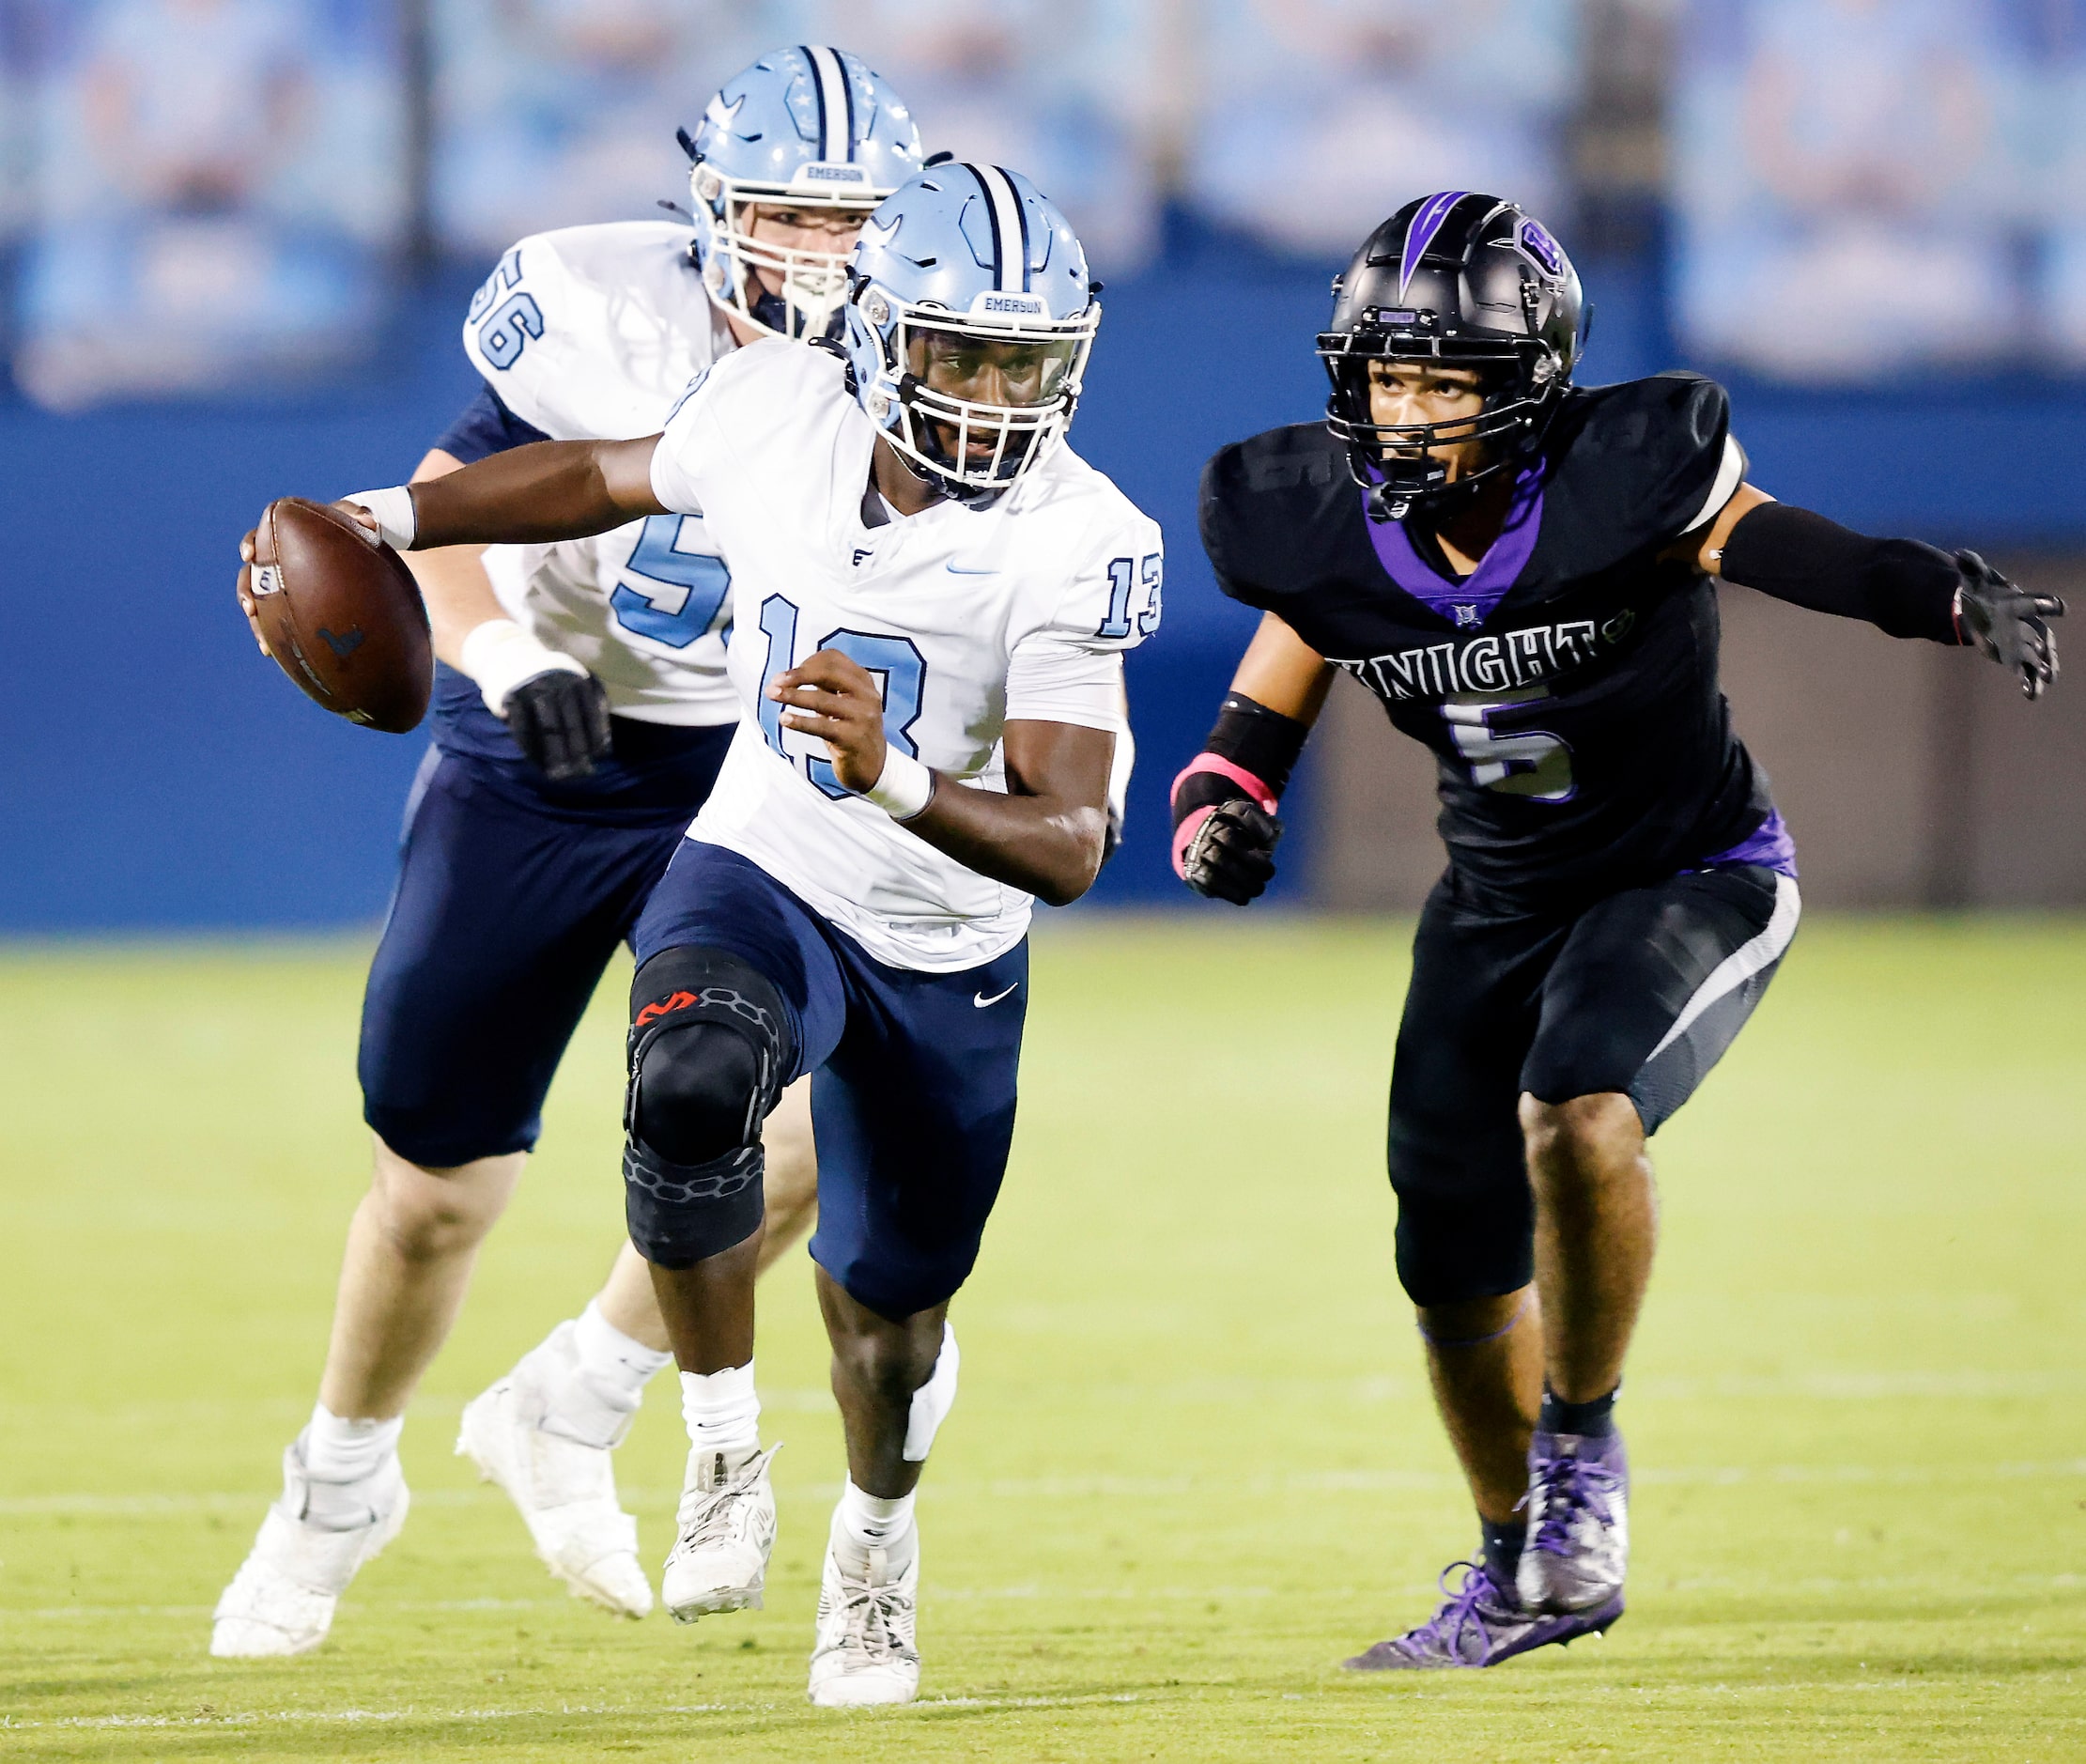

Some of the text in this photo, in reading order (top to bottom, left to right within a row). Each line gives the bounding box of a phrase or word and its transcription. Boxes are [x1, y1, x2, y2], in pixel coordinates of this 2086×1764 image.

[808, 166, 863, 182] EMERSON
[984, 298, 1042, 314] EMERSON
[610, 514, 734, 649] 5
[1095, 552, 1164, 639] 13
[1439, 687, 1579, 804] 5
